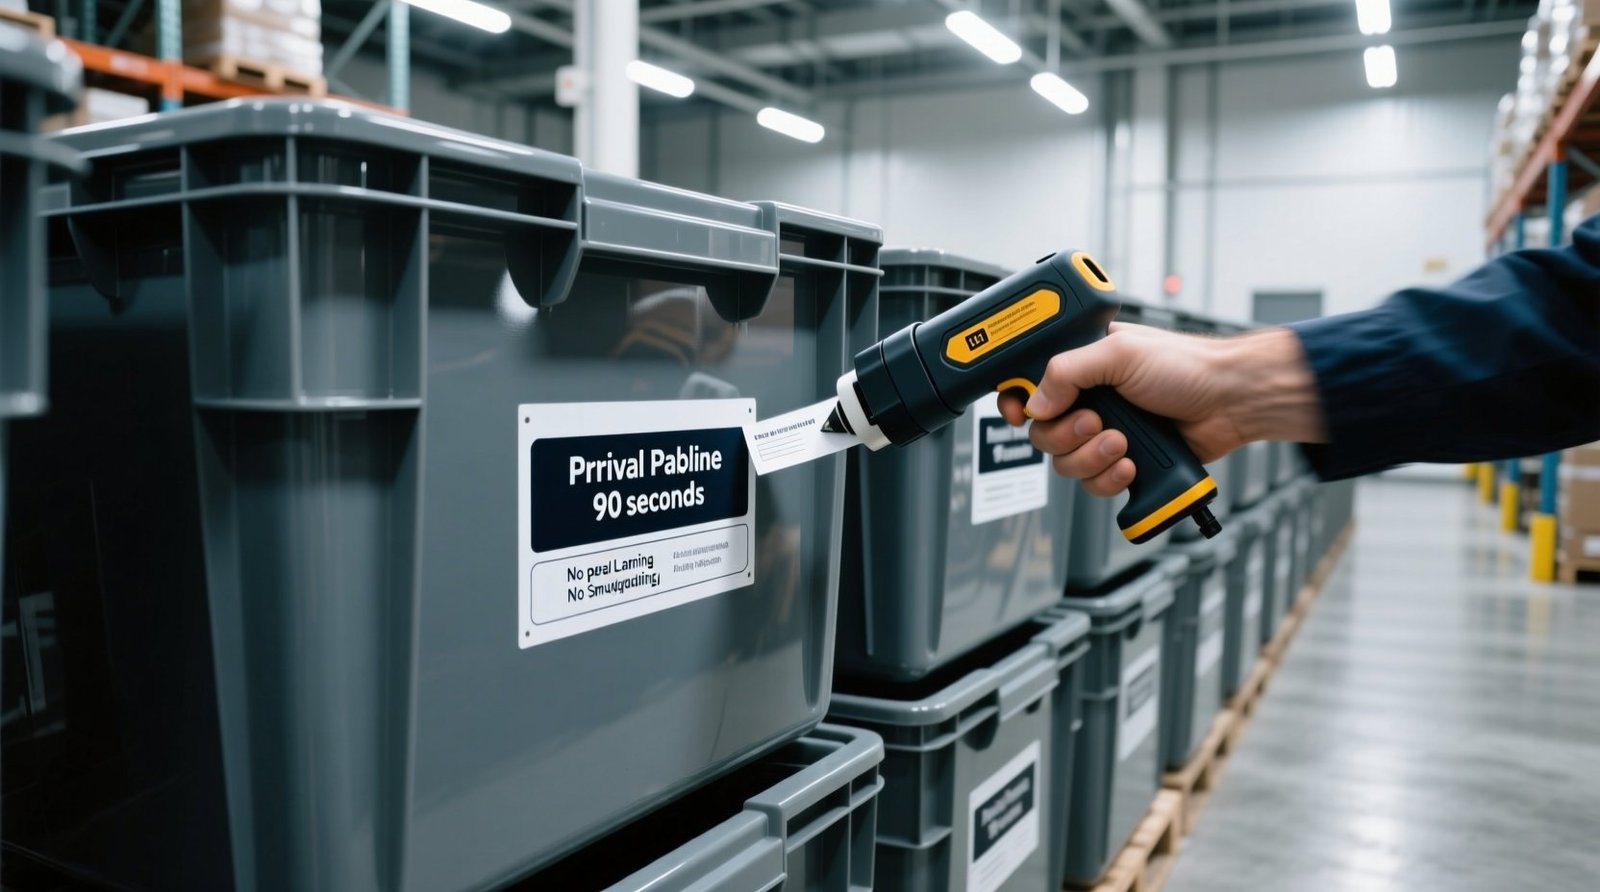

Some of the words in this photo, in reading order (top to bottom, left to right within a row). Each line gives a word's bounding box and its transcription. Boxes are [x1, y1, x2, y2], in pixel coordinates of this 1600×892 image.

[569, 449, 645, 486] Prrival
[650, 444, 722, 476] Pabline
[592, 490, 622, 522] 90
[626, 480, 705, 516] seconds
[567, 567, 584, 582] No
[567, 588, 585, 603] No
